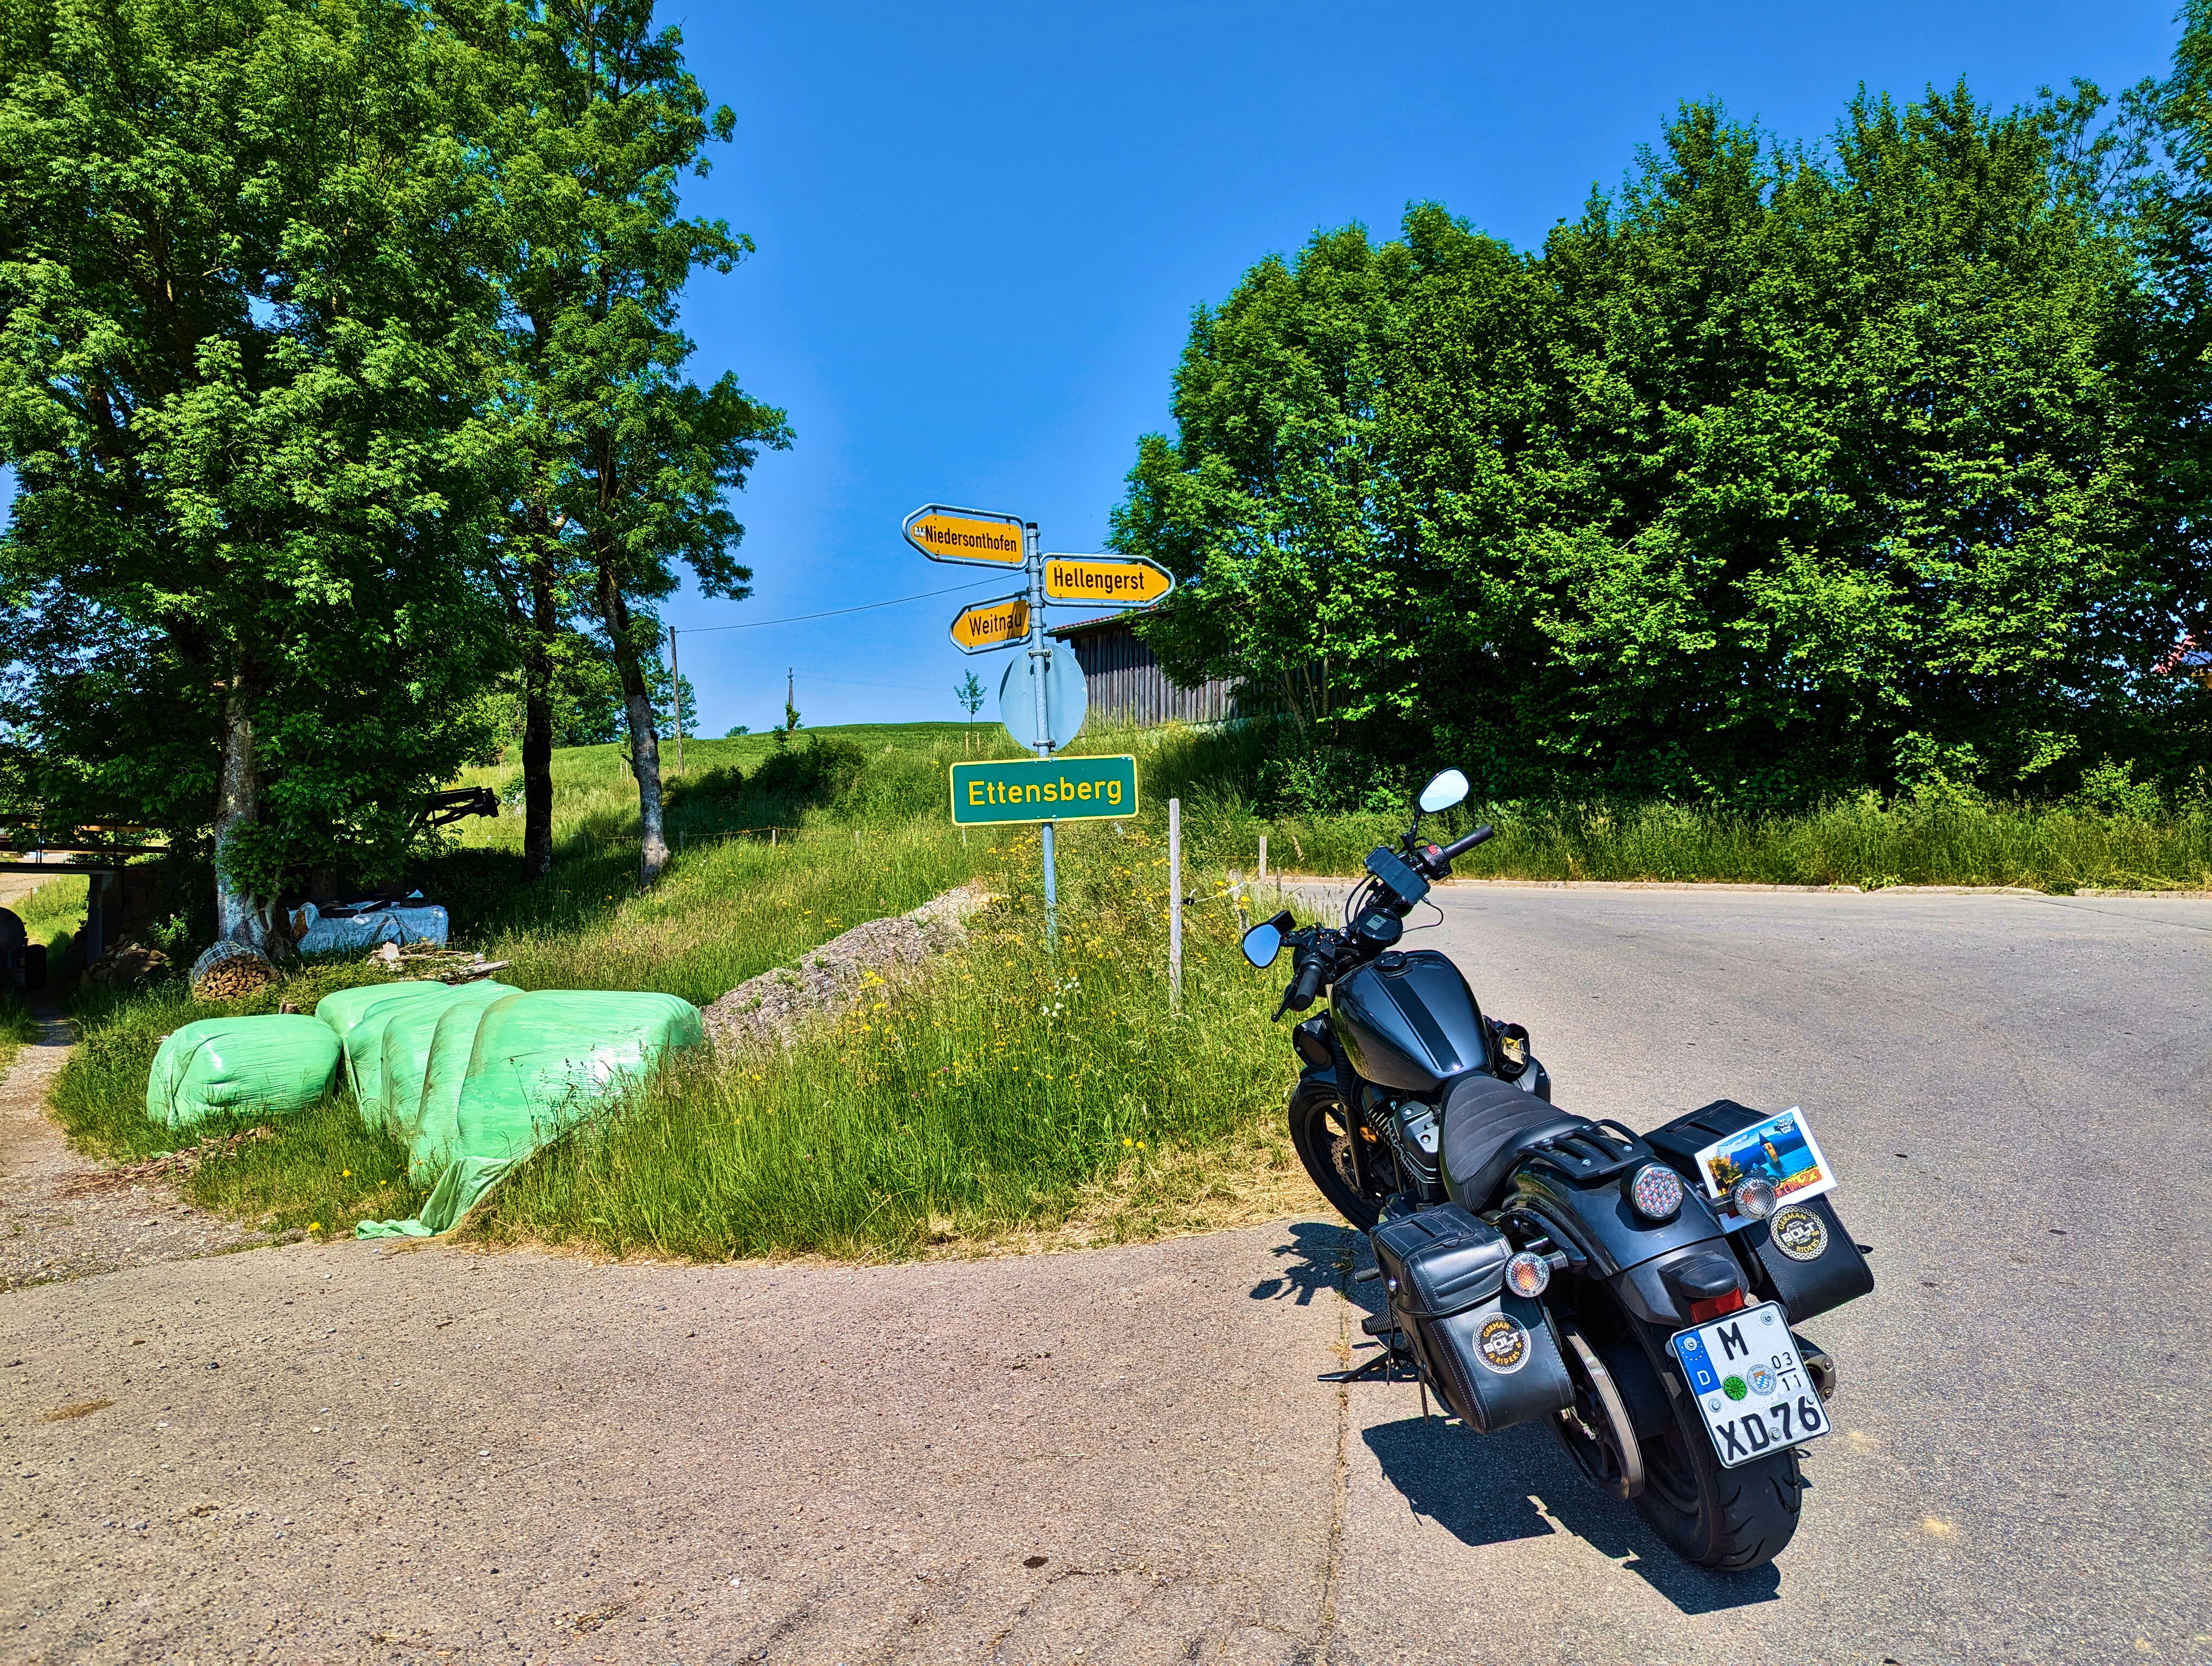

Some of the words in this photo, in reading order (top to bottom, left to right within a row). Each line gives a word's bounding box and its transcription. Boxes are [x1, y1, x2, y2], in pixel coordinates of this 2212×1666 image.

[925, 524, 1017, 552] Niedersonthofen
[1053, 567, 1144, 594] Hellengerst
[969, 612, 1021, 637] Weitnau
[968, 776, 1122, 805] Ettensberg
[1800, 1169, 1822, 1186] 23
[1778, 1212, 1806, 1229] GERMAN
[1780, 1222, 1815, 1243] BOLT
[1796, 1238, 1819, 1252] RIDERS
[1483, 1322, 1509, 1337] GERMAN
[1483, 1331, 1519, 1354] BOLT
[1716, 1322, 1749, 1361] M
[1495, 1350, 1520, 1364] RIDERS
[1771, 1351, 1793, 1369] 03
[1696, 1369, 1711, 1386] D
[1782, 1374, 1802, 1391] 11
